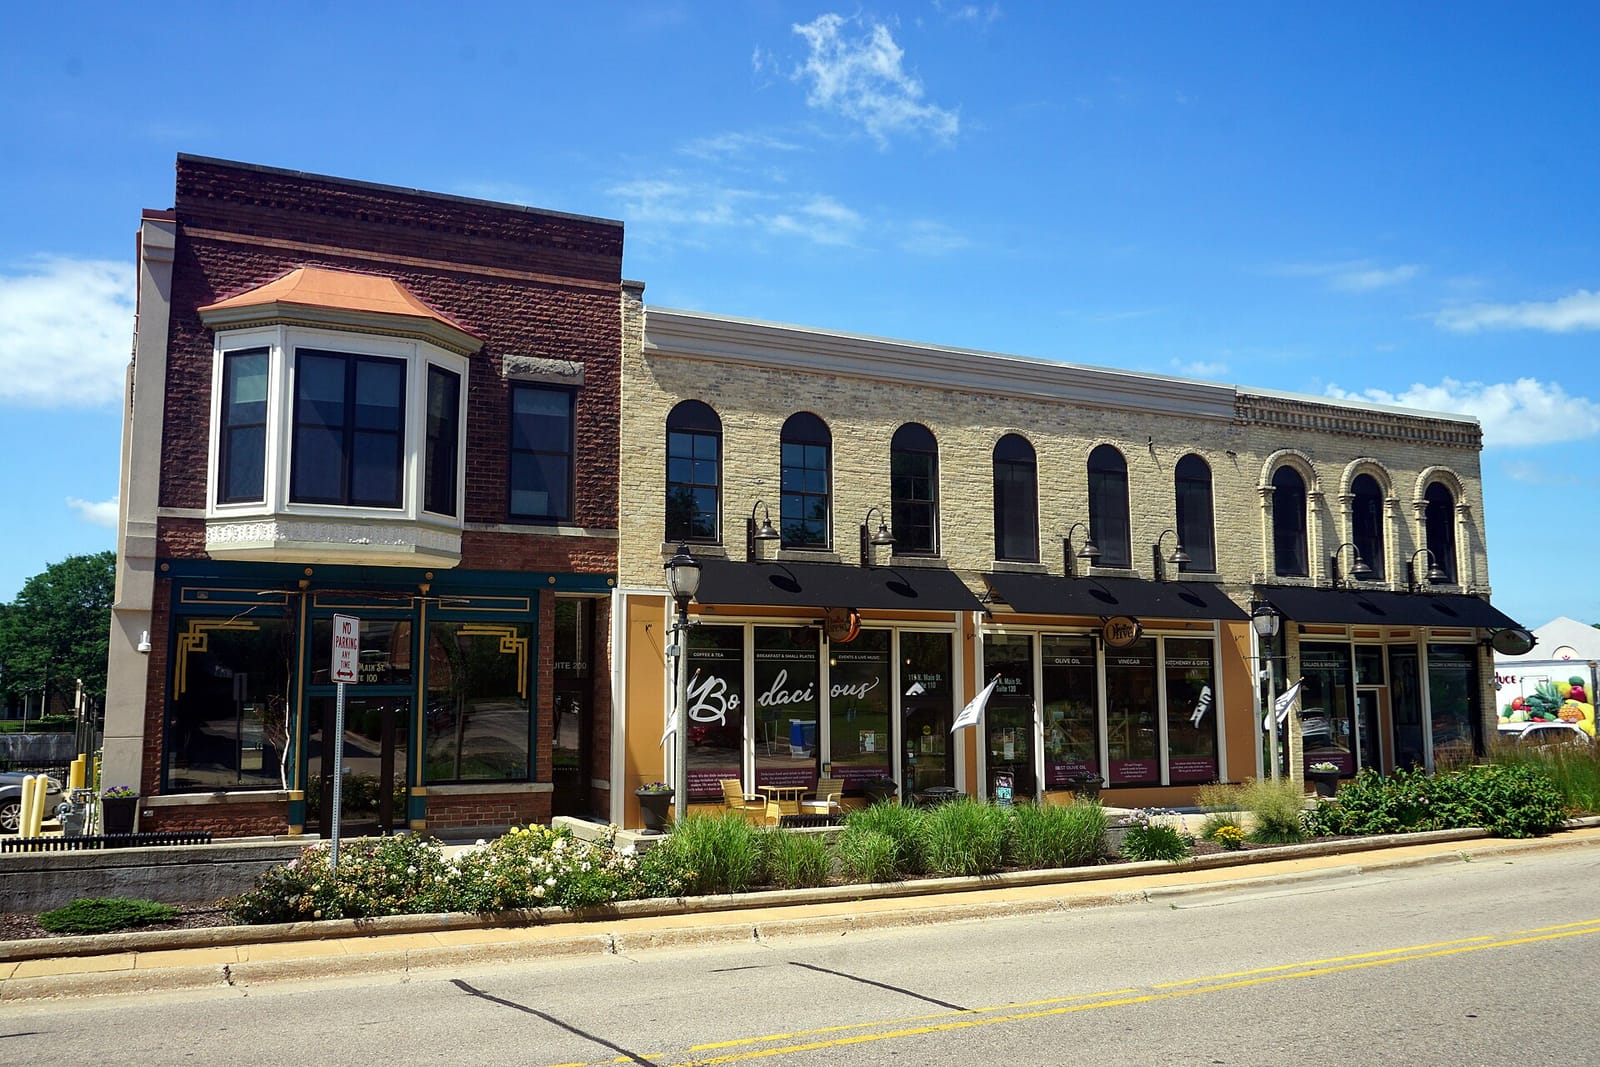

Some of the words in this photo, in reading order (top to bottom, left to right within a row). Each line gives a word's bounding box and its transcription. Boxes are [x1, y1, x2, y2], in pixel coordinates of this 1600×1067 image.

[343, 621, 352, 635] NO
[336, 636, 357, 650] PARKING
[342, 650, 351, 659] ANY
[341, 660, 351, 669] TIME
[554, 661, 571, 669] UITE
[572, 661, 587, 669] 200
[366, 674, 378, 682] 100
[923, 673, 935, 681] Main
